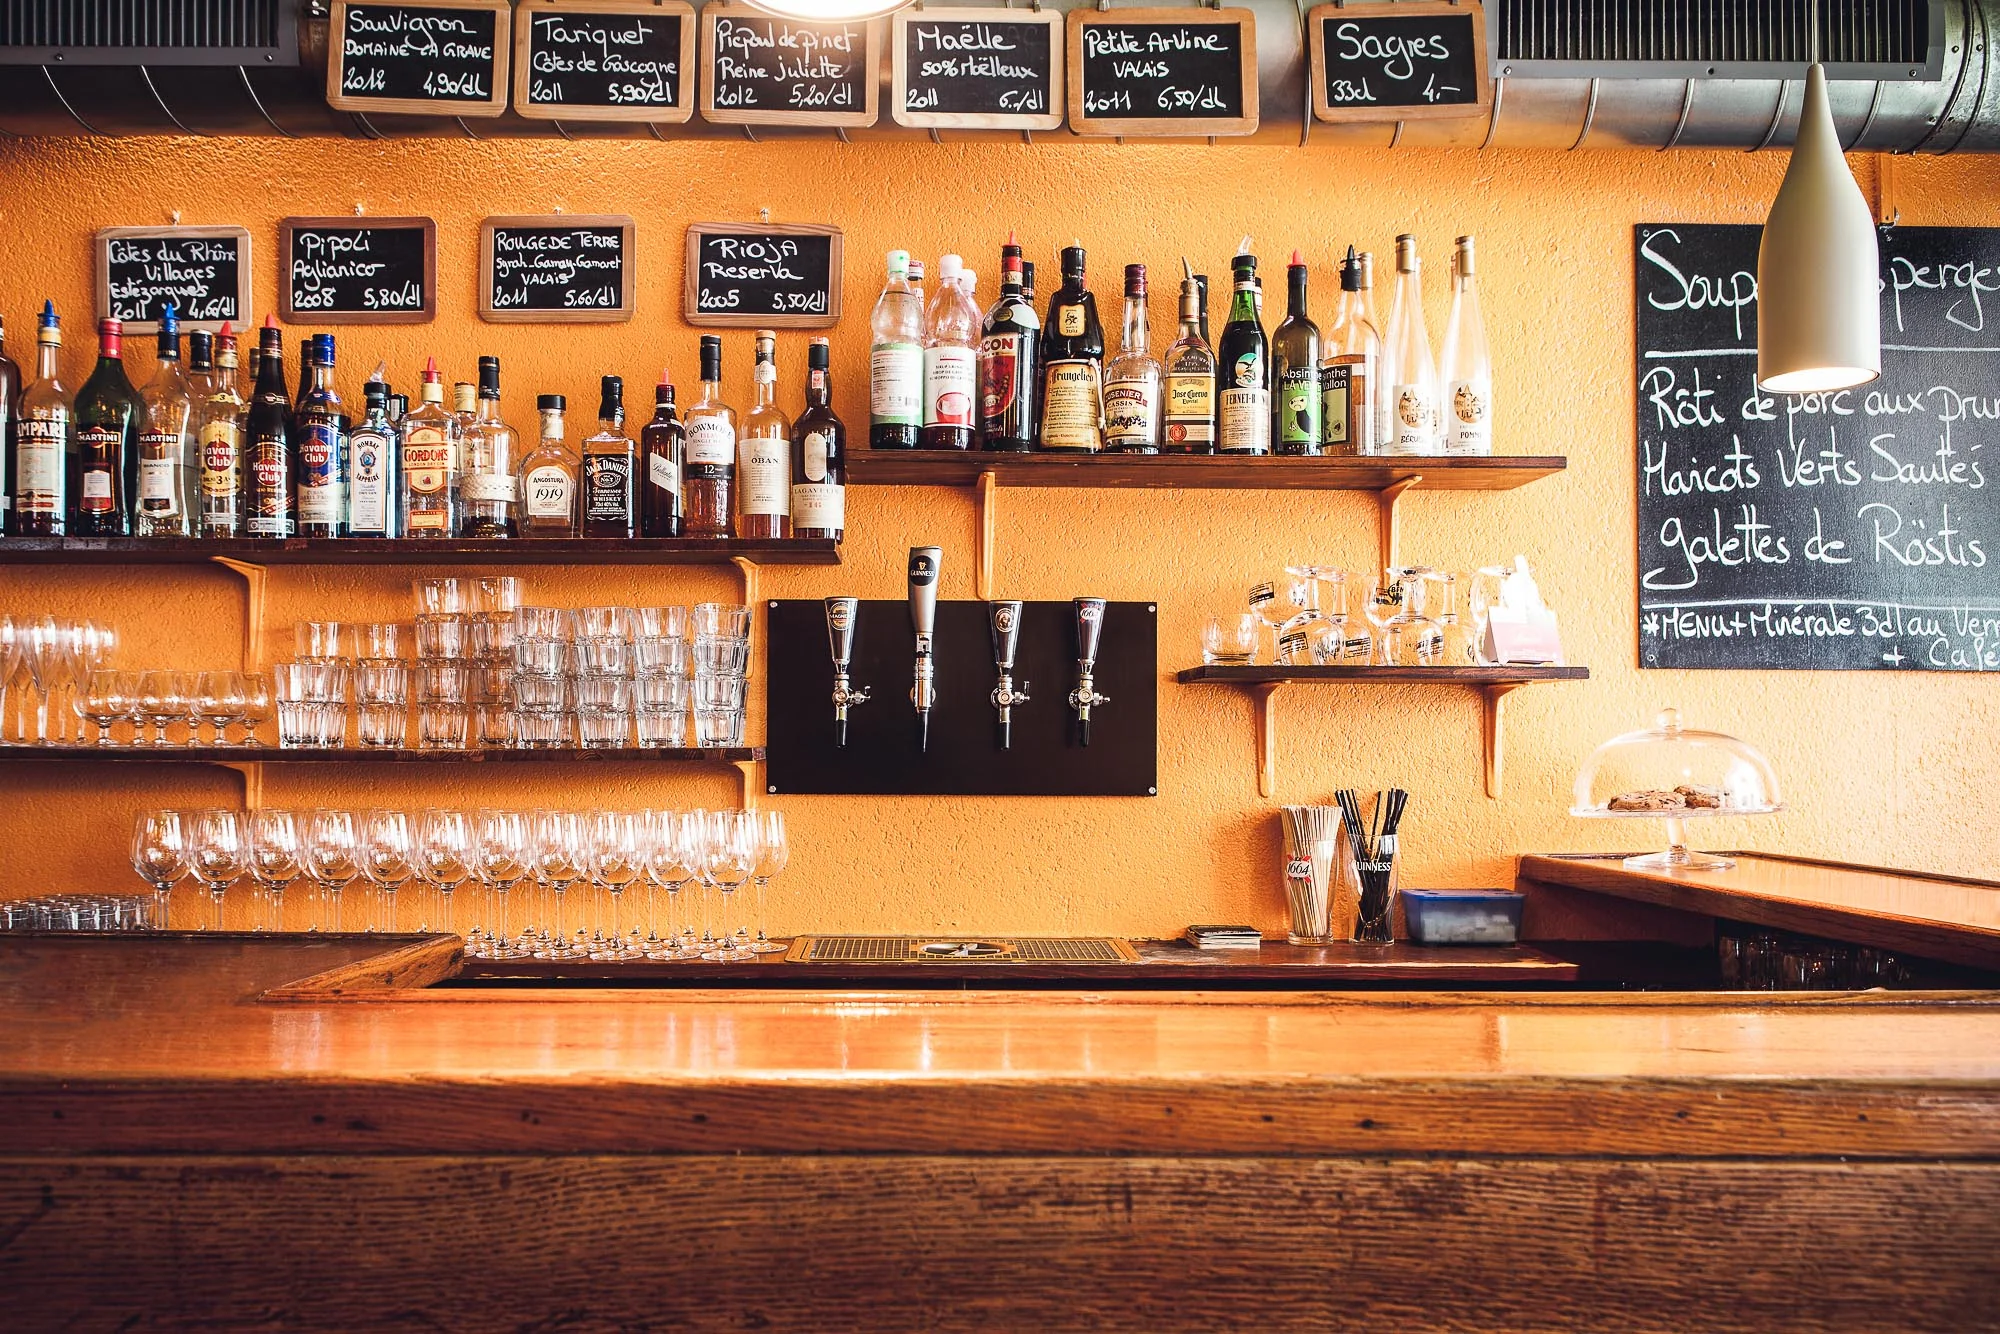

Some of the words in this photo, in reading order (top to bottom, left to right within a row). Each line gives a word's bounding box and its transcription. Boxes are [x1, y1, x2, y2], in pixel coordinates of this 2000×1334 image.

[535, 18, 652, 58] Tariquet
[779, 25, 799, 48] de
[917, 24, 1016, 51] Maëlle
[1085, 29, 1144, 58] Petite
[443, 42, 491, 59] GRAVE
[1337, 23, 1449, 79] Sagres
[534, 51, 573, 72] Côtes
[577, 51, 598, 72] de
[603, 54, 677, 87] Gascogne
[717, 57, 768, 80] Reine
[920, 58, 959, 77] 50%
[344, 66, 385, 91] 2012
[531, 80, 562, 100] 2011
[717, 84, 757, 105] 2012
[906, 88, 938, 108] 2011
[1085, 90, 1131, 112] 2011
[496, 232, 547, 251] ROUGE
[572, 231, 619, 248] TERRE
[109, 241, 151, 263] Côtes
[157, 241, 187, 262] du
[181, 241, 236, 262] Rhône
[144, 262, 215, 293] Villages
[293, 260, 385, 291] Aglianico
[1641, 229, 1758, 340] Soup
[294, 287, 336, 308] 2008
[494, 286, 527, 306] 2011
[699, 288, 739, 308] 2005
[113, 302, 146, 319] 2011
[1173, 390, 1186, 399] Jose
[1187, 390, 1208, 398] Cuervo
[1641, 367, 1725, 430] Rôti
[1742, 373, 1777, 421] de
[1787, 389, 1854, 450] porc
[1864, 391, 1925, 416] aux
[79, 433, 118, 442] MARTINI
[357, 441, 379, 450] BOMBAY
[207, 456, 231, 466] Club
[304, 454, 325, 462] Club
[1777, 426, 1862, 487] Verts
[1870, 433, 1985, 489] Sautés
[259, 472, 280, 481] Club
[704, 465, 714, 473] 12
[536, 489, 563, 501] 1919
[1805, 508, 1851, 564] de
[1858, 504, 1987, 567] Röstis
[1907, 617, 1947, 636] au
[1929, 637, 2000, 671] Café
[1352, 860, 1391, 871] UINNESS
